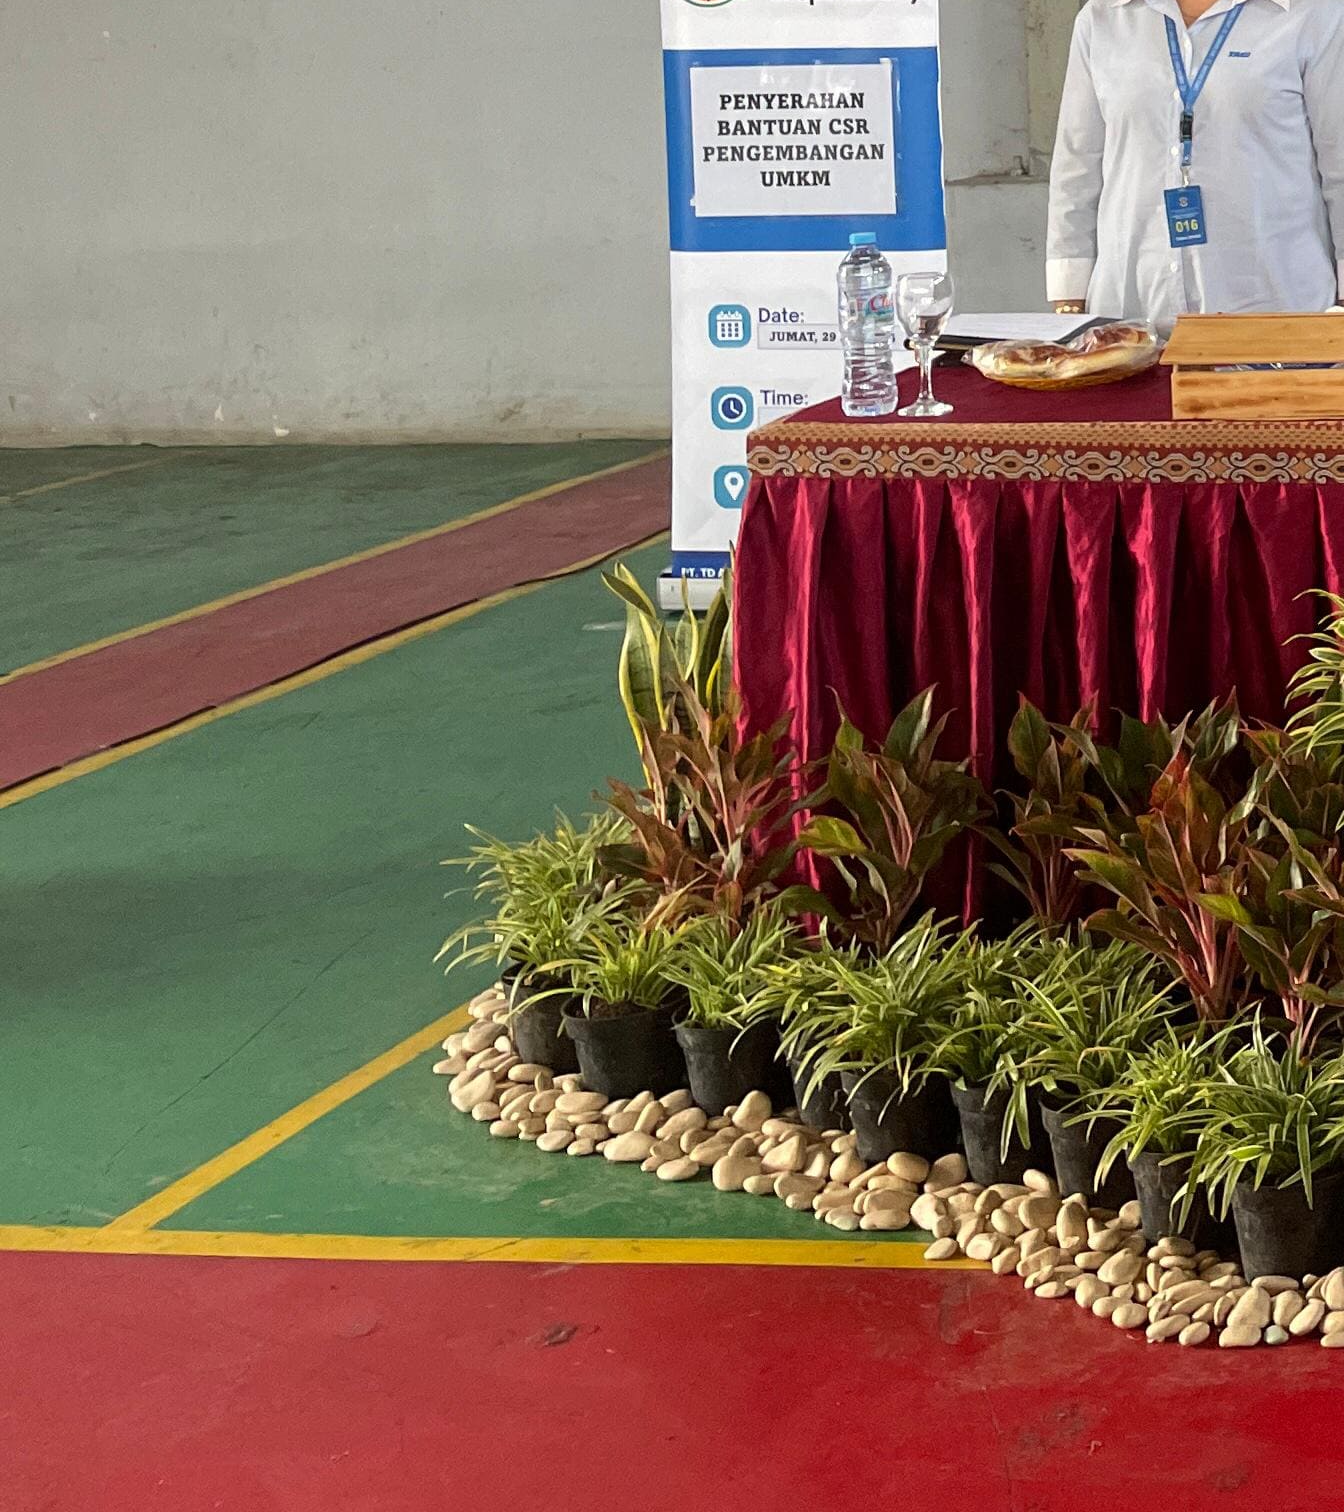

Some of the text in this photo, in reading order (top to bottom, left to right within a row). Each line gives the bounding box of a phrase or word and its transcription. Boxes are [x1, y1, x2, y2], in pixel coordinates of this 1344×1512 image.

[719, 92, 865, 111] PENYERAHAN
[717, 118, 870, 136] BANTUAN CSR
[703, 143, 885, 162] PENGEMBANGAN
[760, 170, 831, 187] UMKM
[1175, 218, 1199, 233] 016
[758, 307, 805, 323] Date:
[769, 331, 837, 343] JUMAT, 29
[760, 389, 809, 405] Time:
